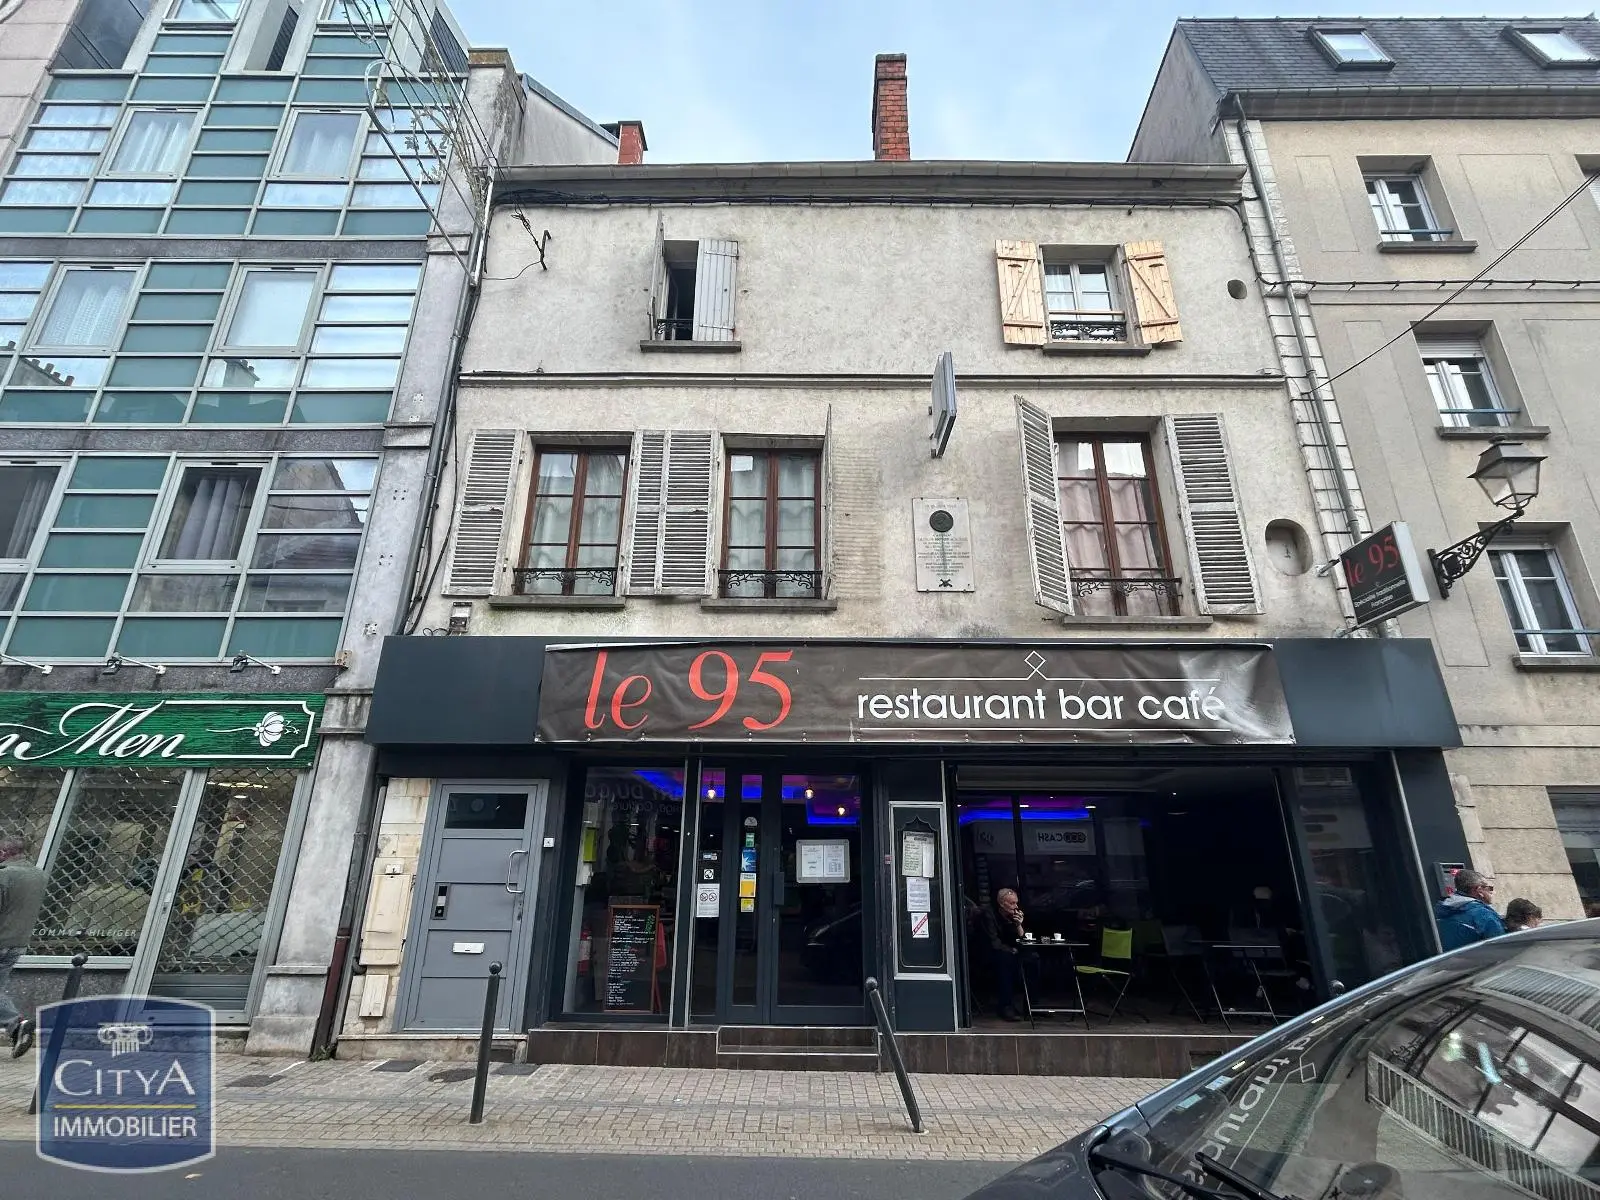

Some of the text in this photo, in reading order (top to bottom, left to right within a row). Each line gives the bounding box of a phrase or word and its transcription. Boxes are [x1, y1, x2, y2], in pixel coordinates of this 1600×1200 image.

[1345, 536, 1398, 588] le 95
[584, 650, 793, 730] le 95
[857, 687, 1226, 721] restaurant bar café
[14, 700, 186, 760] Men
[32, 928, 136, 937] TOMMY HILFIGER
